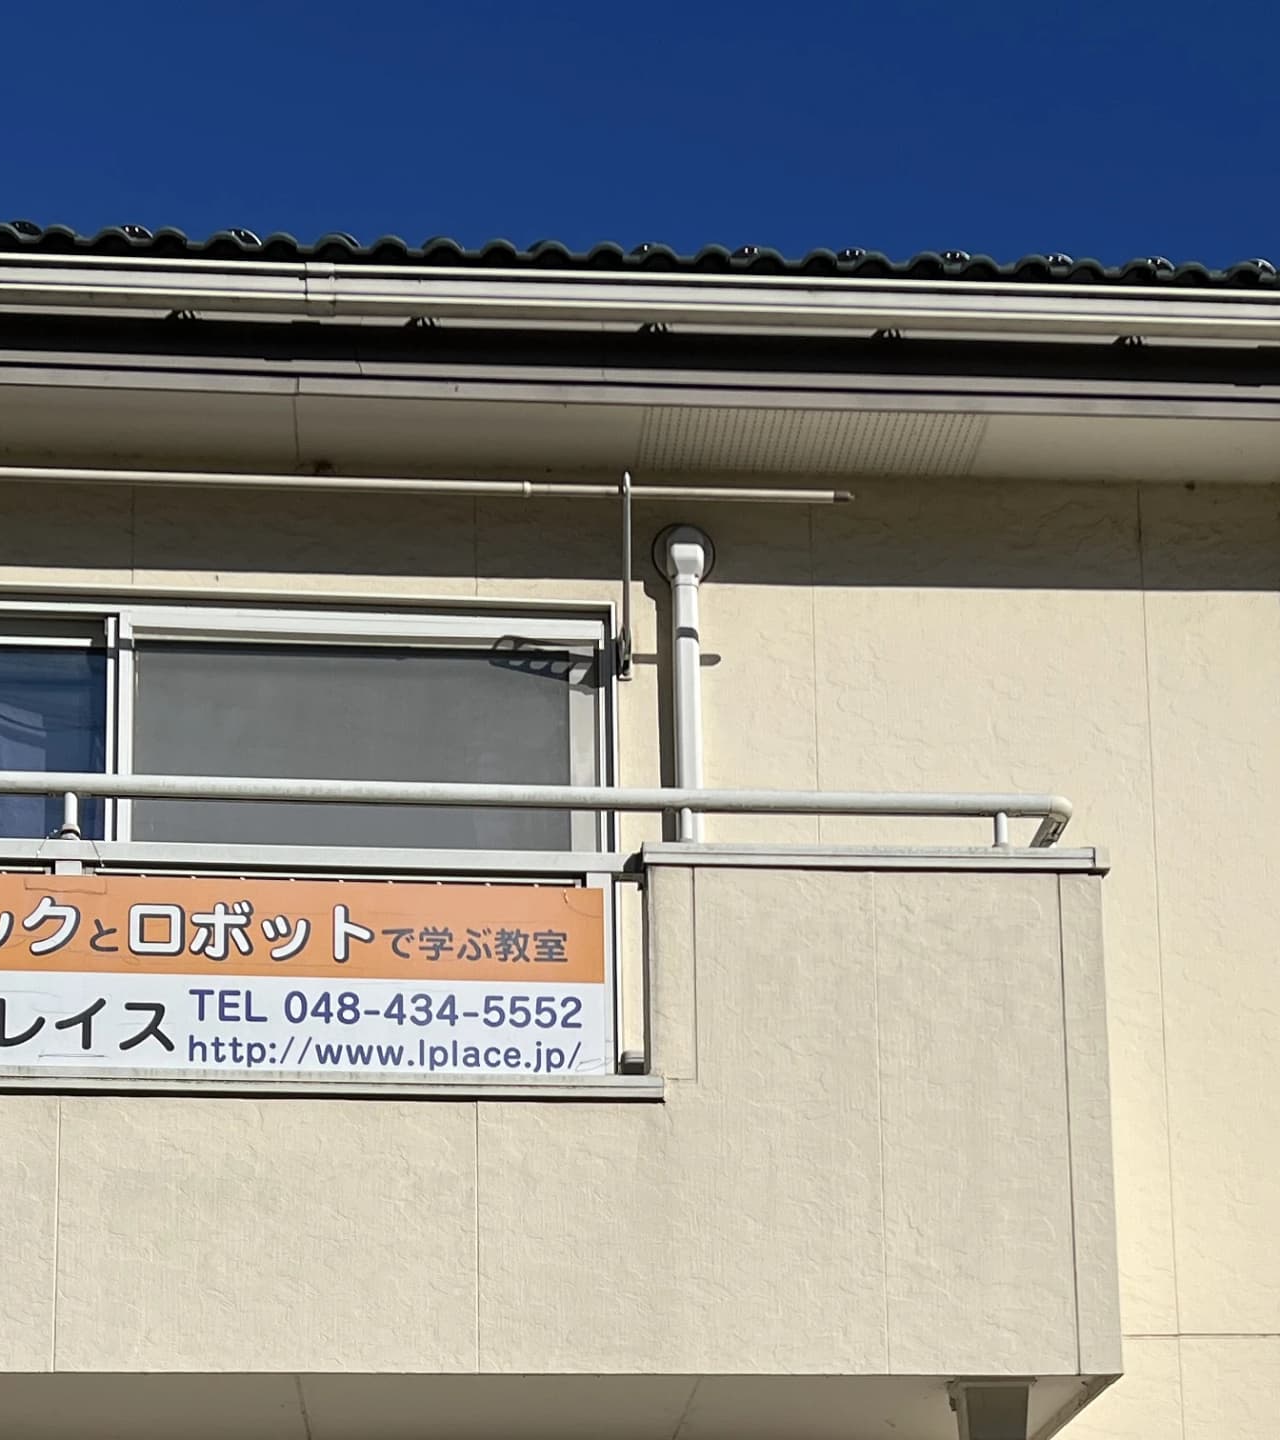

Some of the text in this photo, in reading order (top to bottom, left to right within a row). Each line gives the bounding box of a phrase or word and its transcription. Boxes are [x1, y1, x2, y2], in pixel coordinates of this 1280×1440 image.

[189, 988, 583, 1029] TEL 048-434-5552
[188, 1034, 582, 1074] http://www.lplace.jp/
